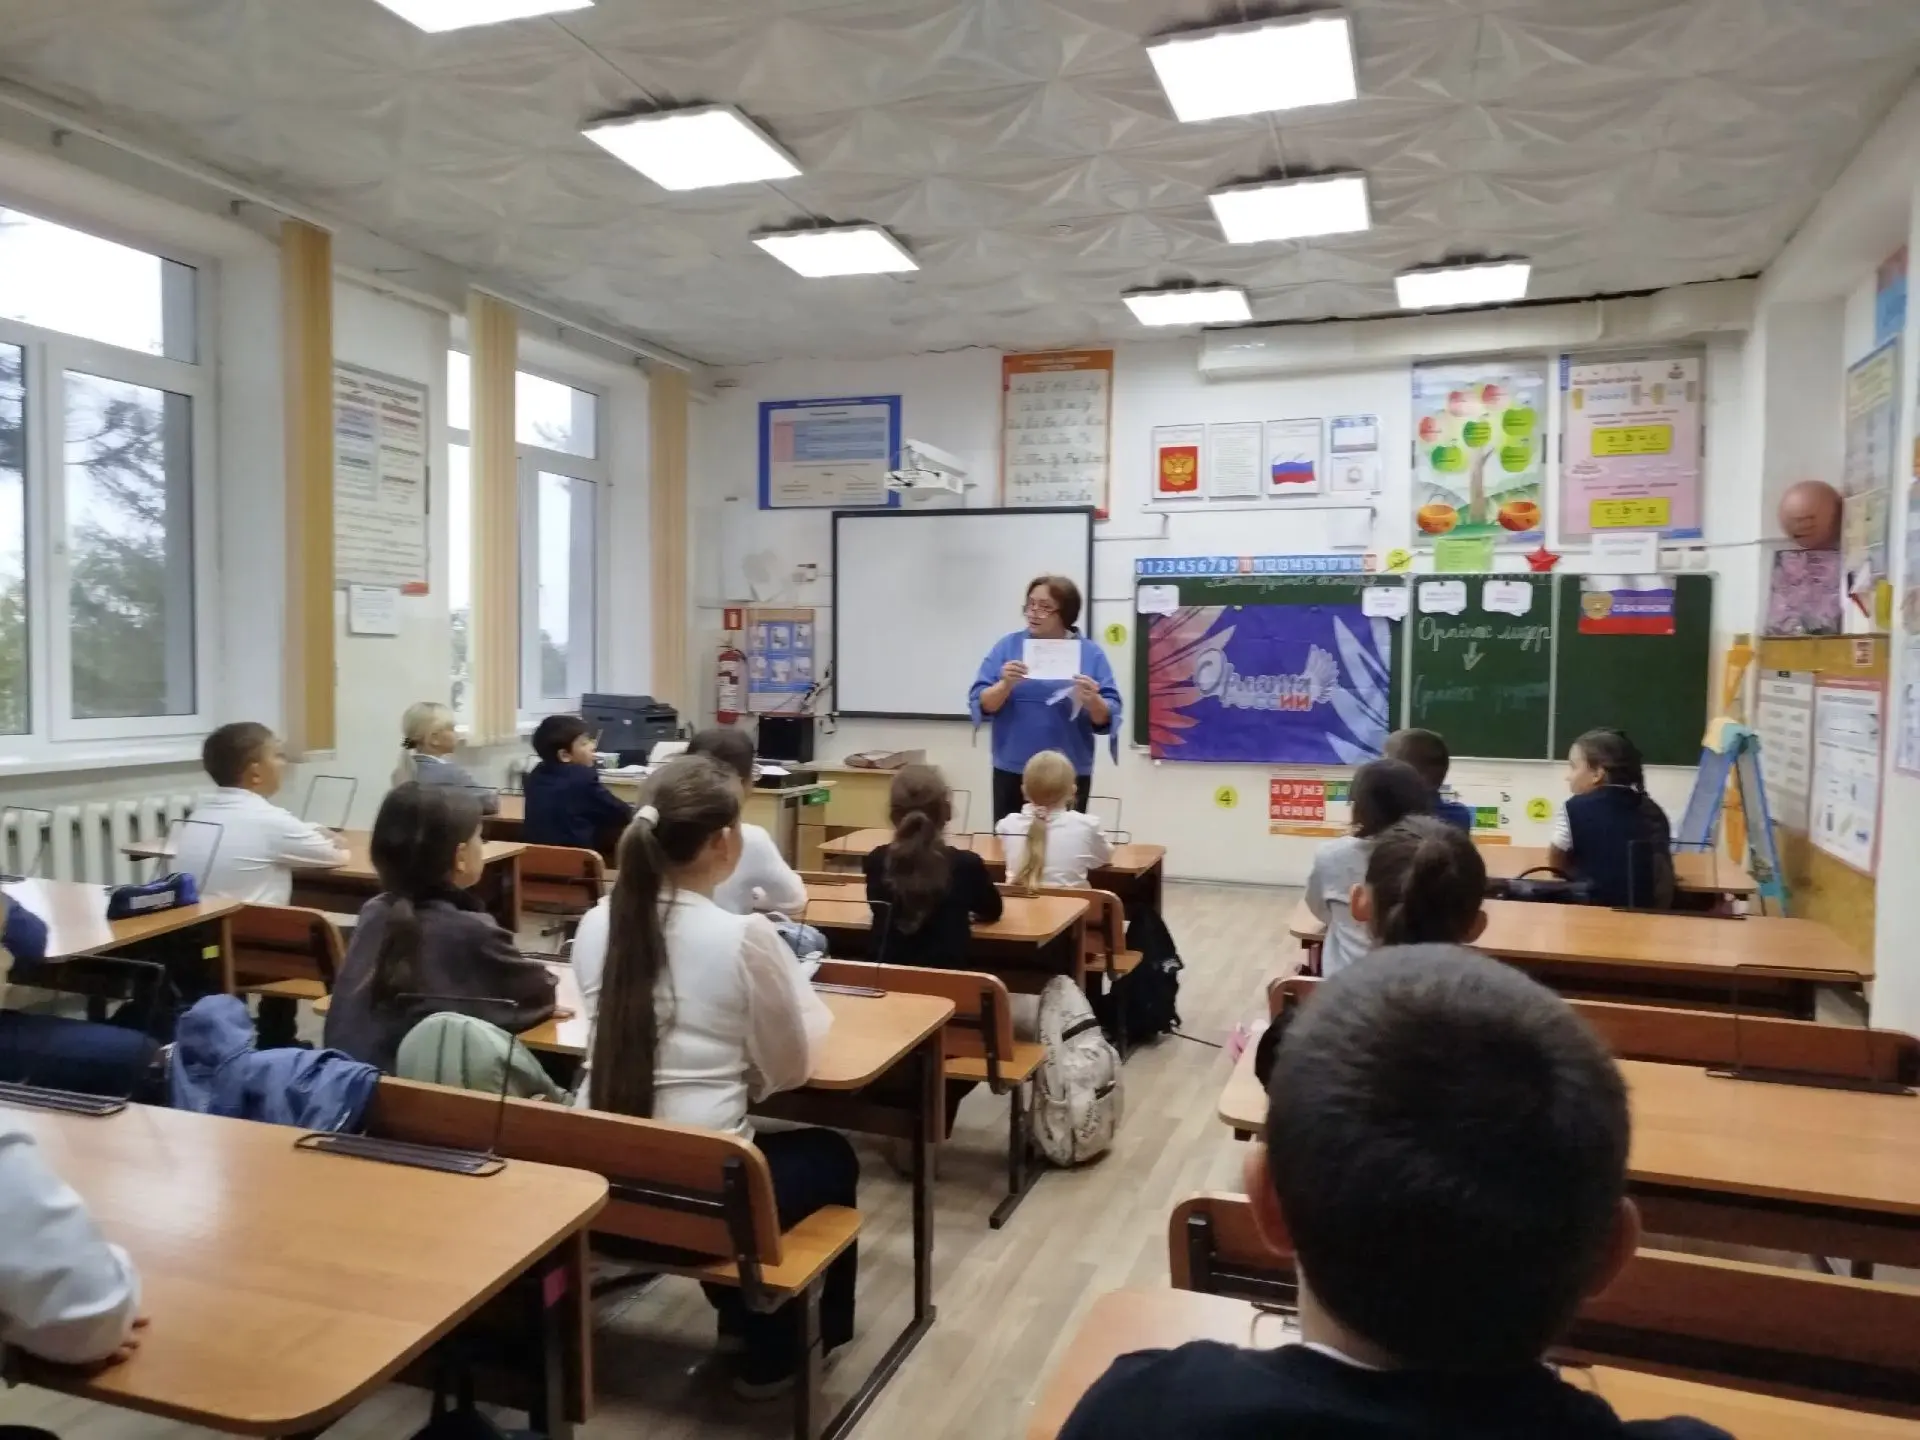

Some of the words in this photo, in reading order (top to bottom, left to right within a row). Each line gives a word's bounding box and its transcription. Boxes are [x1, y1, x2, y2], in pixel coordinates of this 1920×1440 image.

[1110, 627, 1120, 642] 1
[1219, 789, 1232, 805] 4
[1533, 801, 1546, 818] 2
